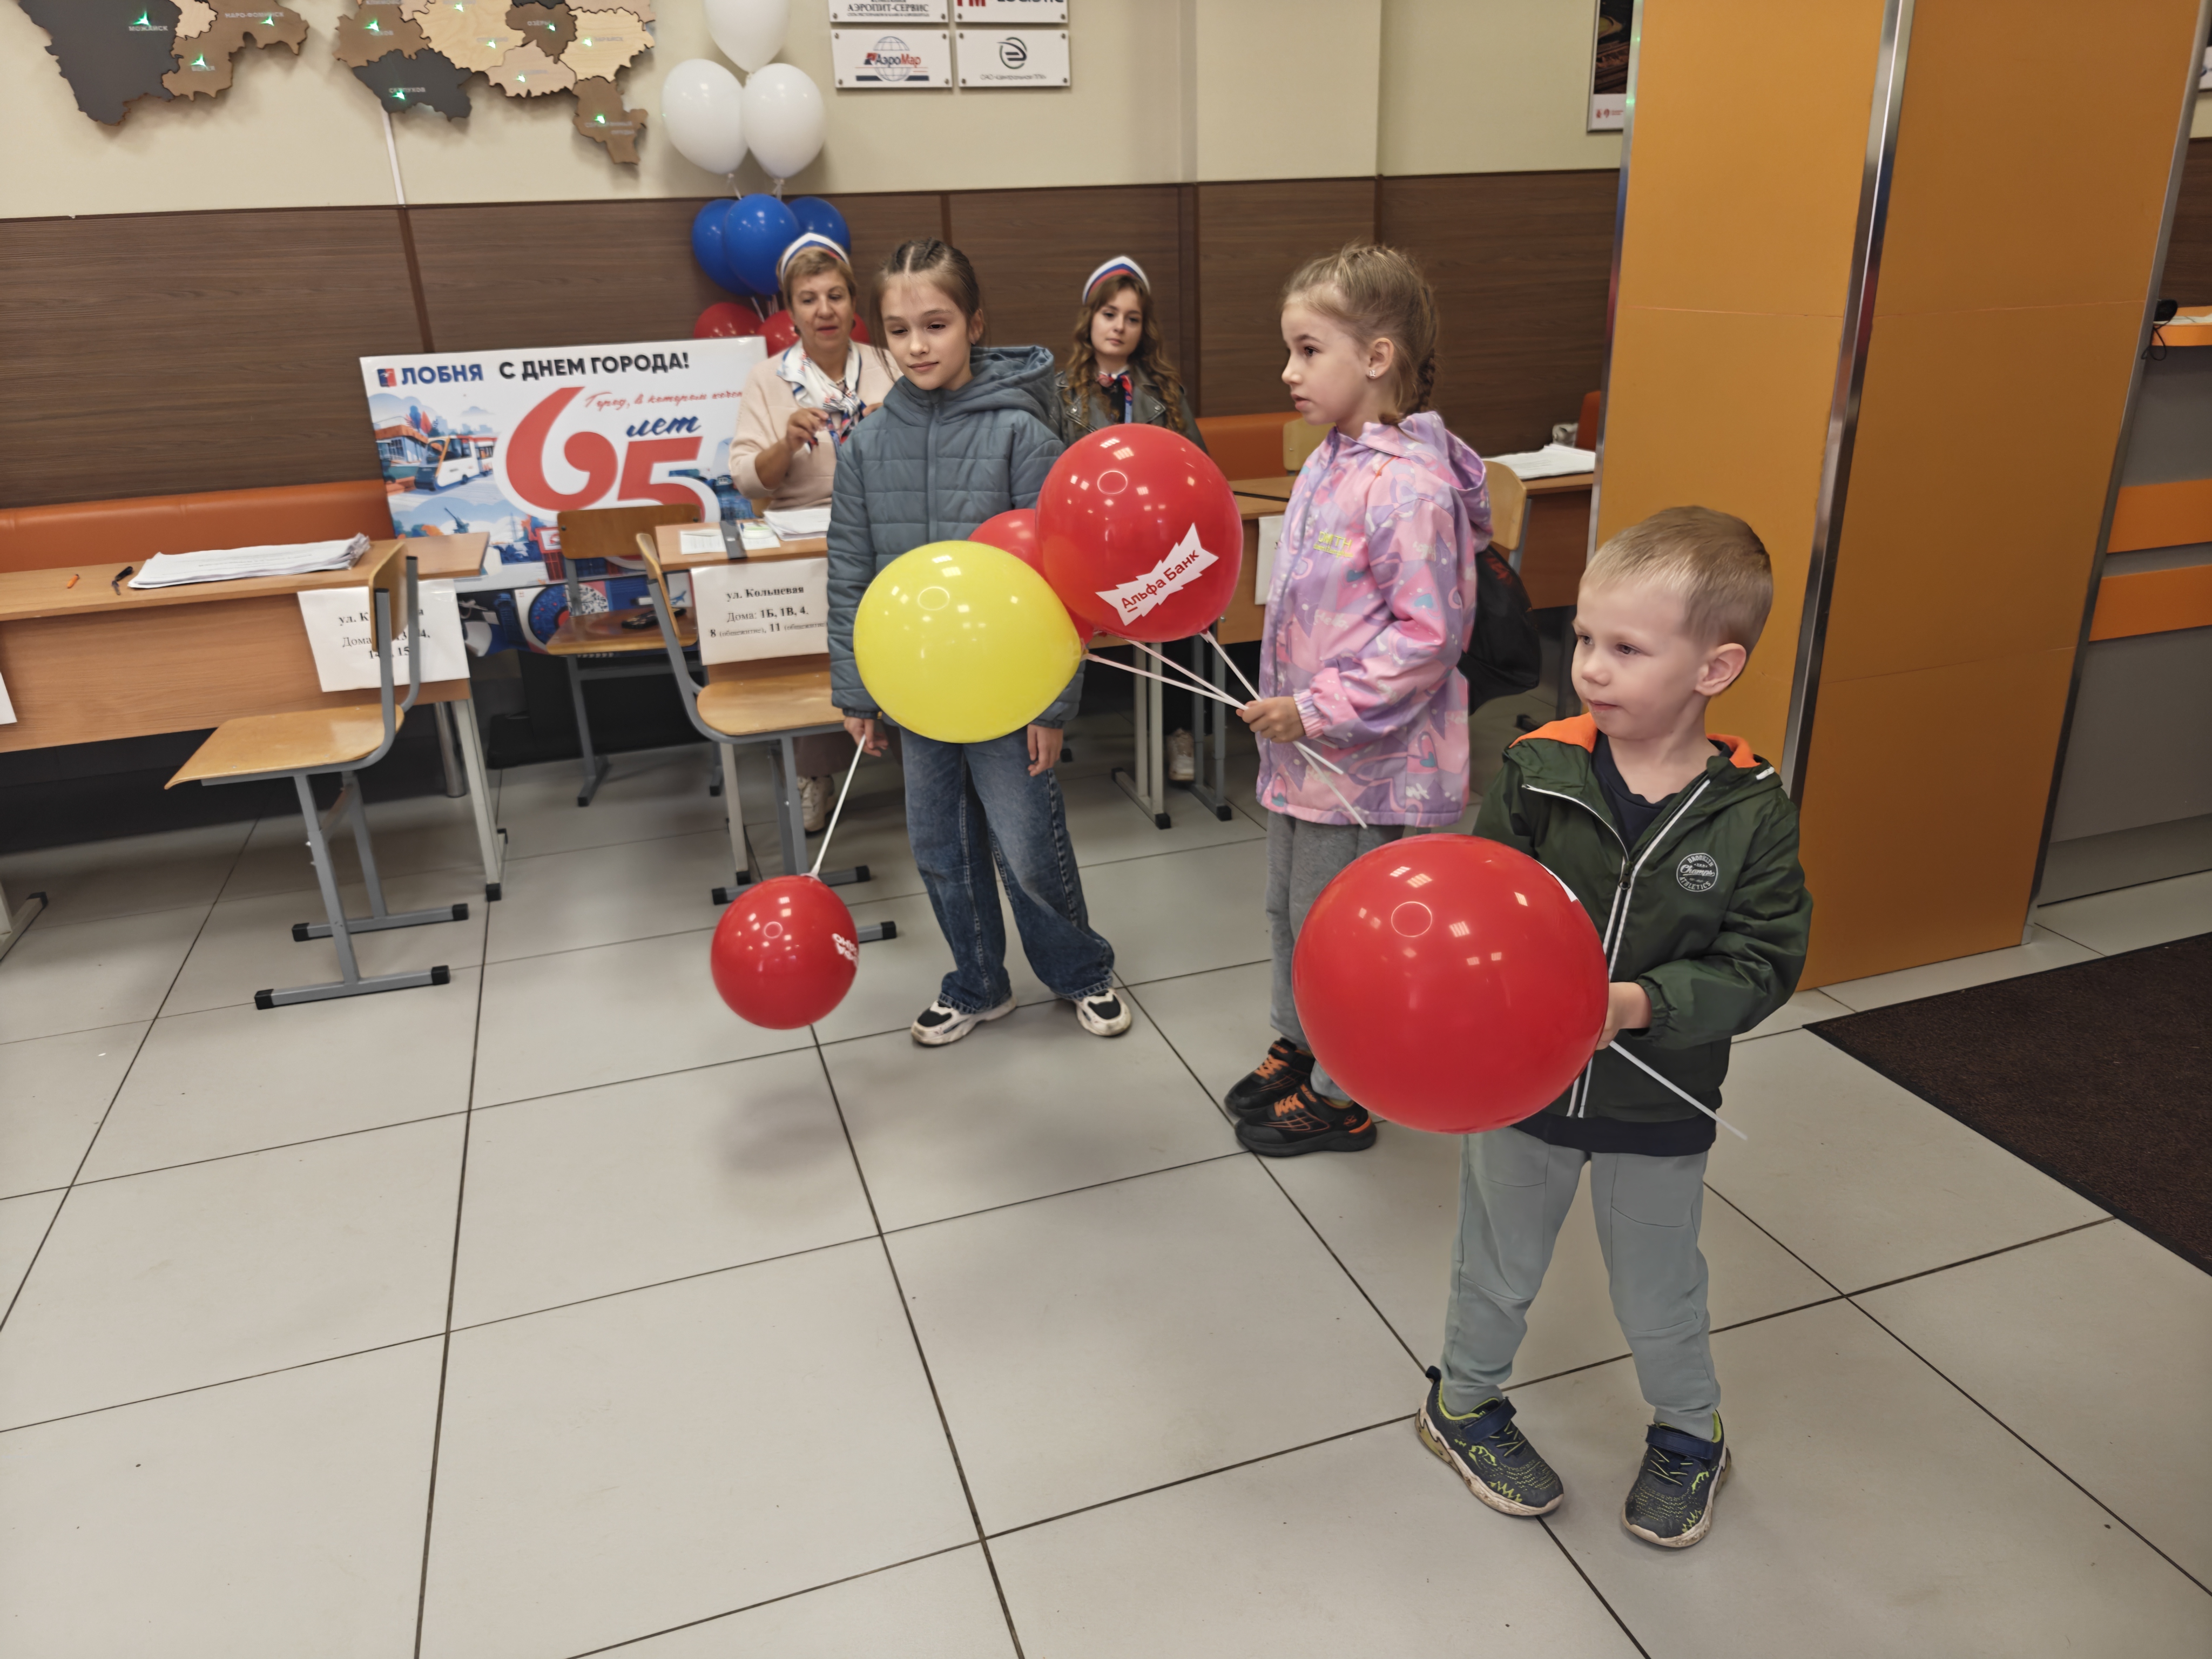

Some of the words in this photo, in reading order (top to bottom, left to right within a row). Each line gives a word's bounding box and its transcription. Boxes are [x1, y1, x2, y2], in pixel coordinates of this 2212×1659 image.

[875, 53, 921, 68] АэроМар
[401, 363, 484, 385] ЛОБНЯ
[498, 361, 516, 380] С
[522, 358, 586, 381] ДНЕМ
[590, 352, 690, 374] ГОРОДА!
[634, 393, 644, 404] в
[625, 415, 702, 438] лет
[505, 386, 706, 523] 65
[1121, 579, 1167, 610] Альфа
[1163, 549, 1200, 582] Банк
[726, 592, 742, 602] ул.
[745, 586, 805, 598] Кольцевая
[339, 616, 356, 626] ул.
[726, 612, 757, 623] Дома:
[760, 609, 778, 618] 1Б,
[780, 606, 798, 617] 1В,
[710, 629, 717, 638] 8
[770, 623, 781, 632] 11
[1680, 864, 1716, 877] Champs
[1678, 876, 1711, 890] ATHLETICS
